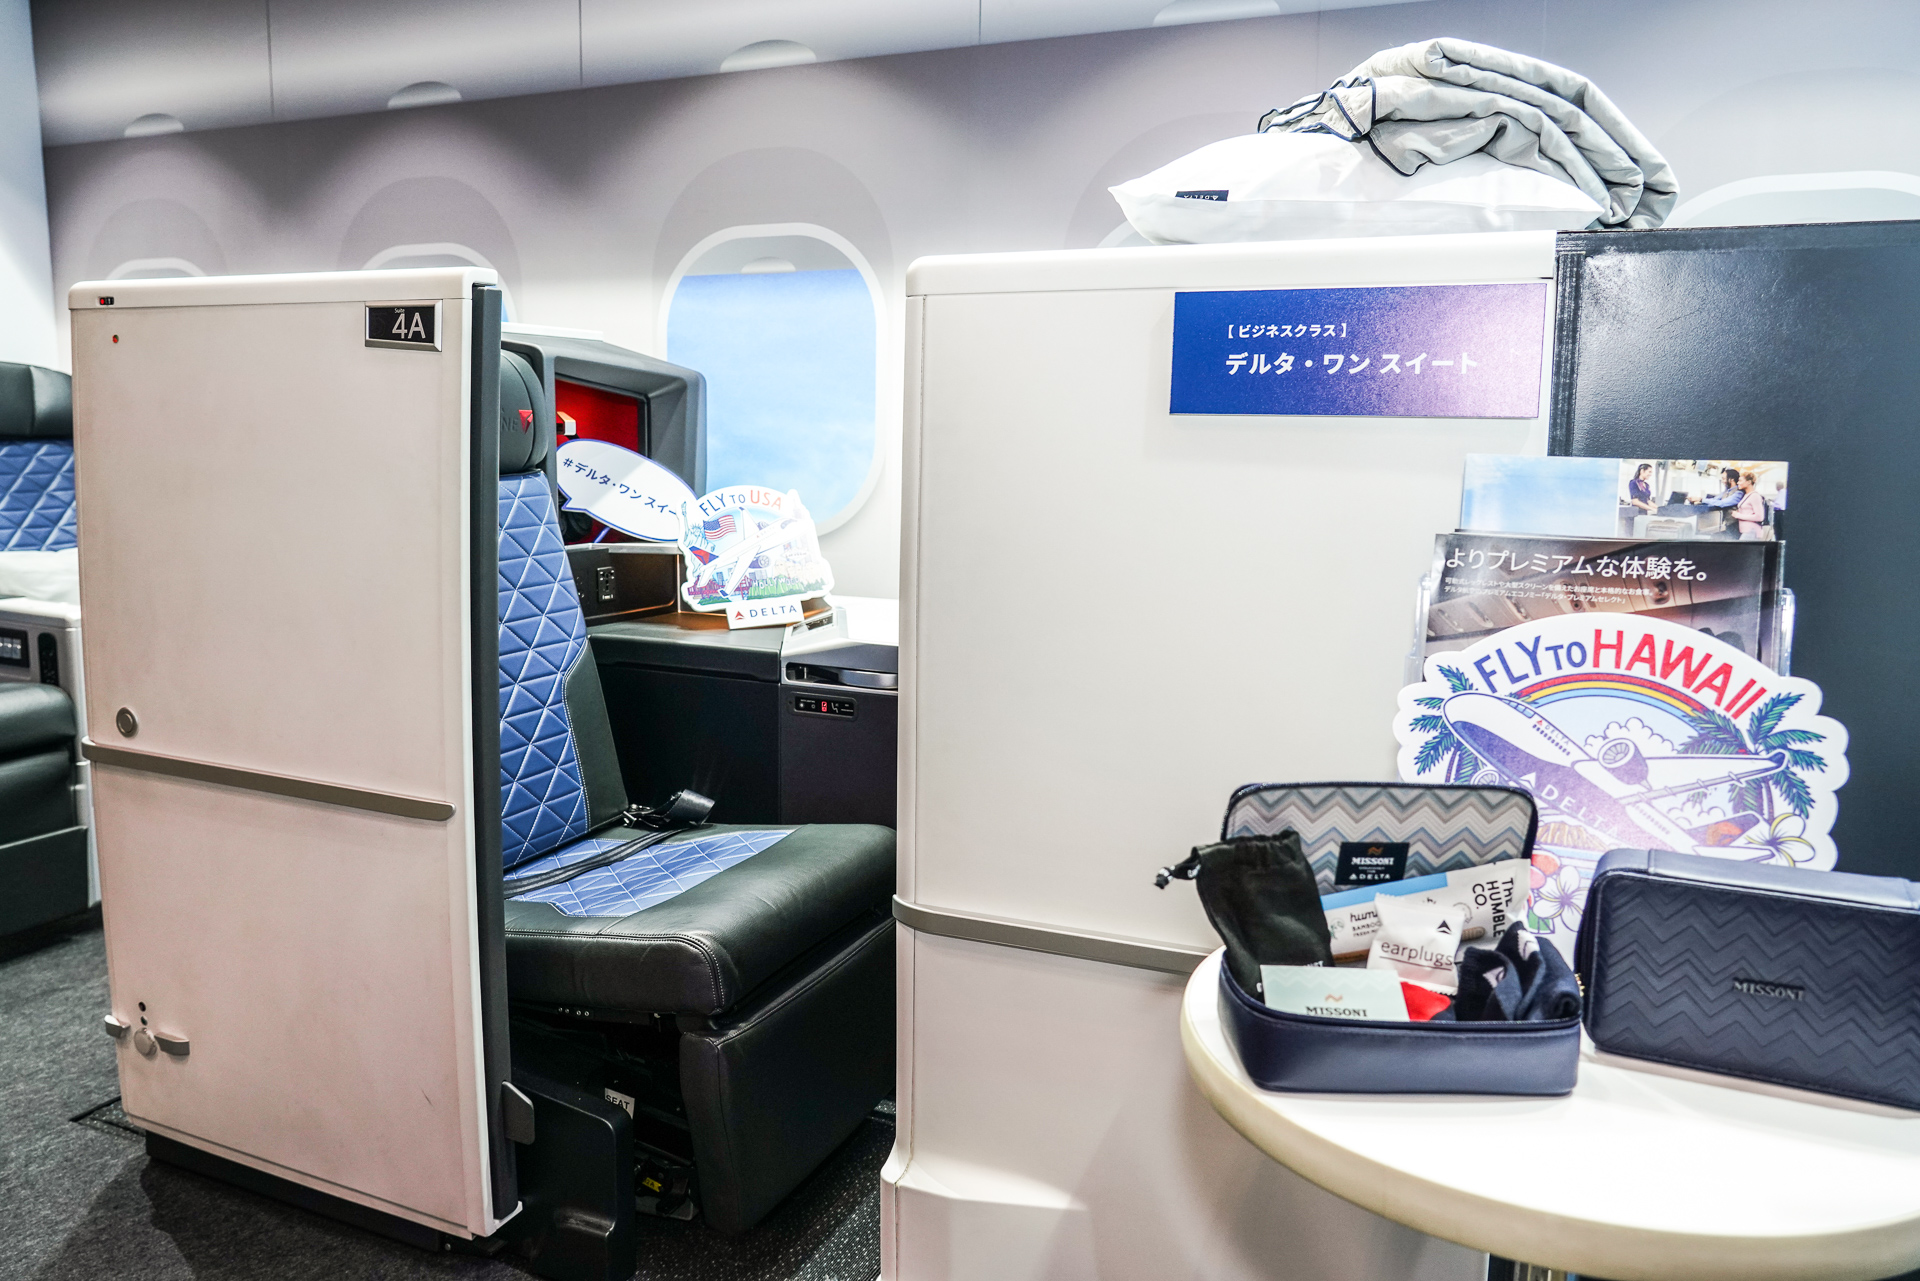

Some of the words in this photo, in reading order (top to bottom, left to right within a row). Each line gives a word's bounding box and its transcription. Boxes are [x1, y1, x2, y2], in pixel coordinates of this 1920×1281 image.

[392, 312, 426, 339] 4A
[1227, 322, 1348, 339] 【ビジネスクラス】
[1225, 352, 1370, 375] デルタ・ワン
[1379, 351, 1478, 375] スイート
[644, 495, 678, 517] スイー
[699, 492, 728, 517] FLY
[729, 493, 746, 506] TO
[750, 489, 783, 511] USA
[1446, 548, 1708, 582] よりプレミアムな体験を。
[750, 604, 798, 618] DELTA
[1473, 635, 1542, 694] FLY
[1545, 641, 1587, 671] TO
[1592, 629, 1767, 720] HAWAII
[1544, 724, 1570, 746] DELTA
[1541, 784, 1619, 837] DELTA
[1350, 856, 1395, 866] MISSONI
[1472, 883, 1487, 909] CO.
[1502, 877, 1514, 907] THE
[1486, 880, 1506, 938] HUMBLE
[1381, 941, 1454, 967] earplugs
[1734, 980, 1804, 1001] MISSONI
[1305, 1006, 1368, 1017] MISSONI
[606, 1094, 630, 1109] SEAT
